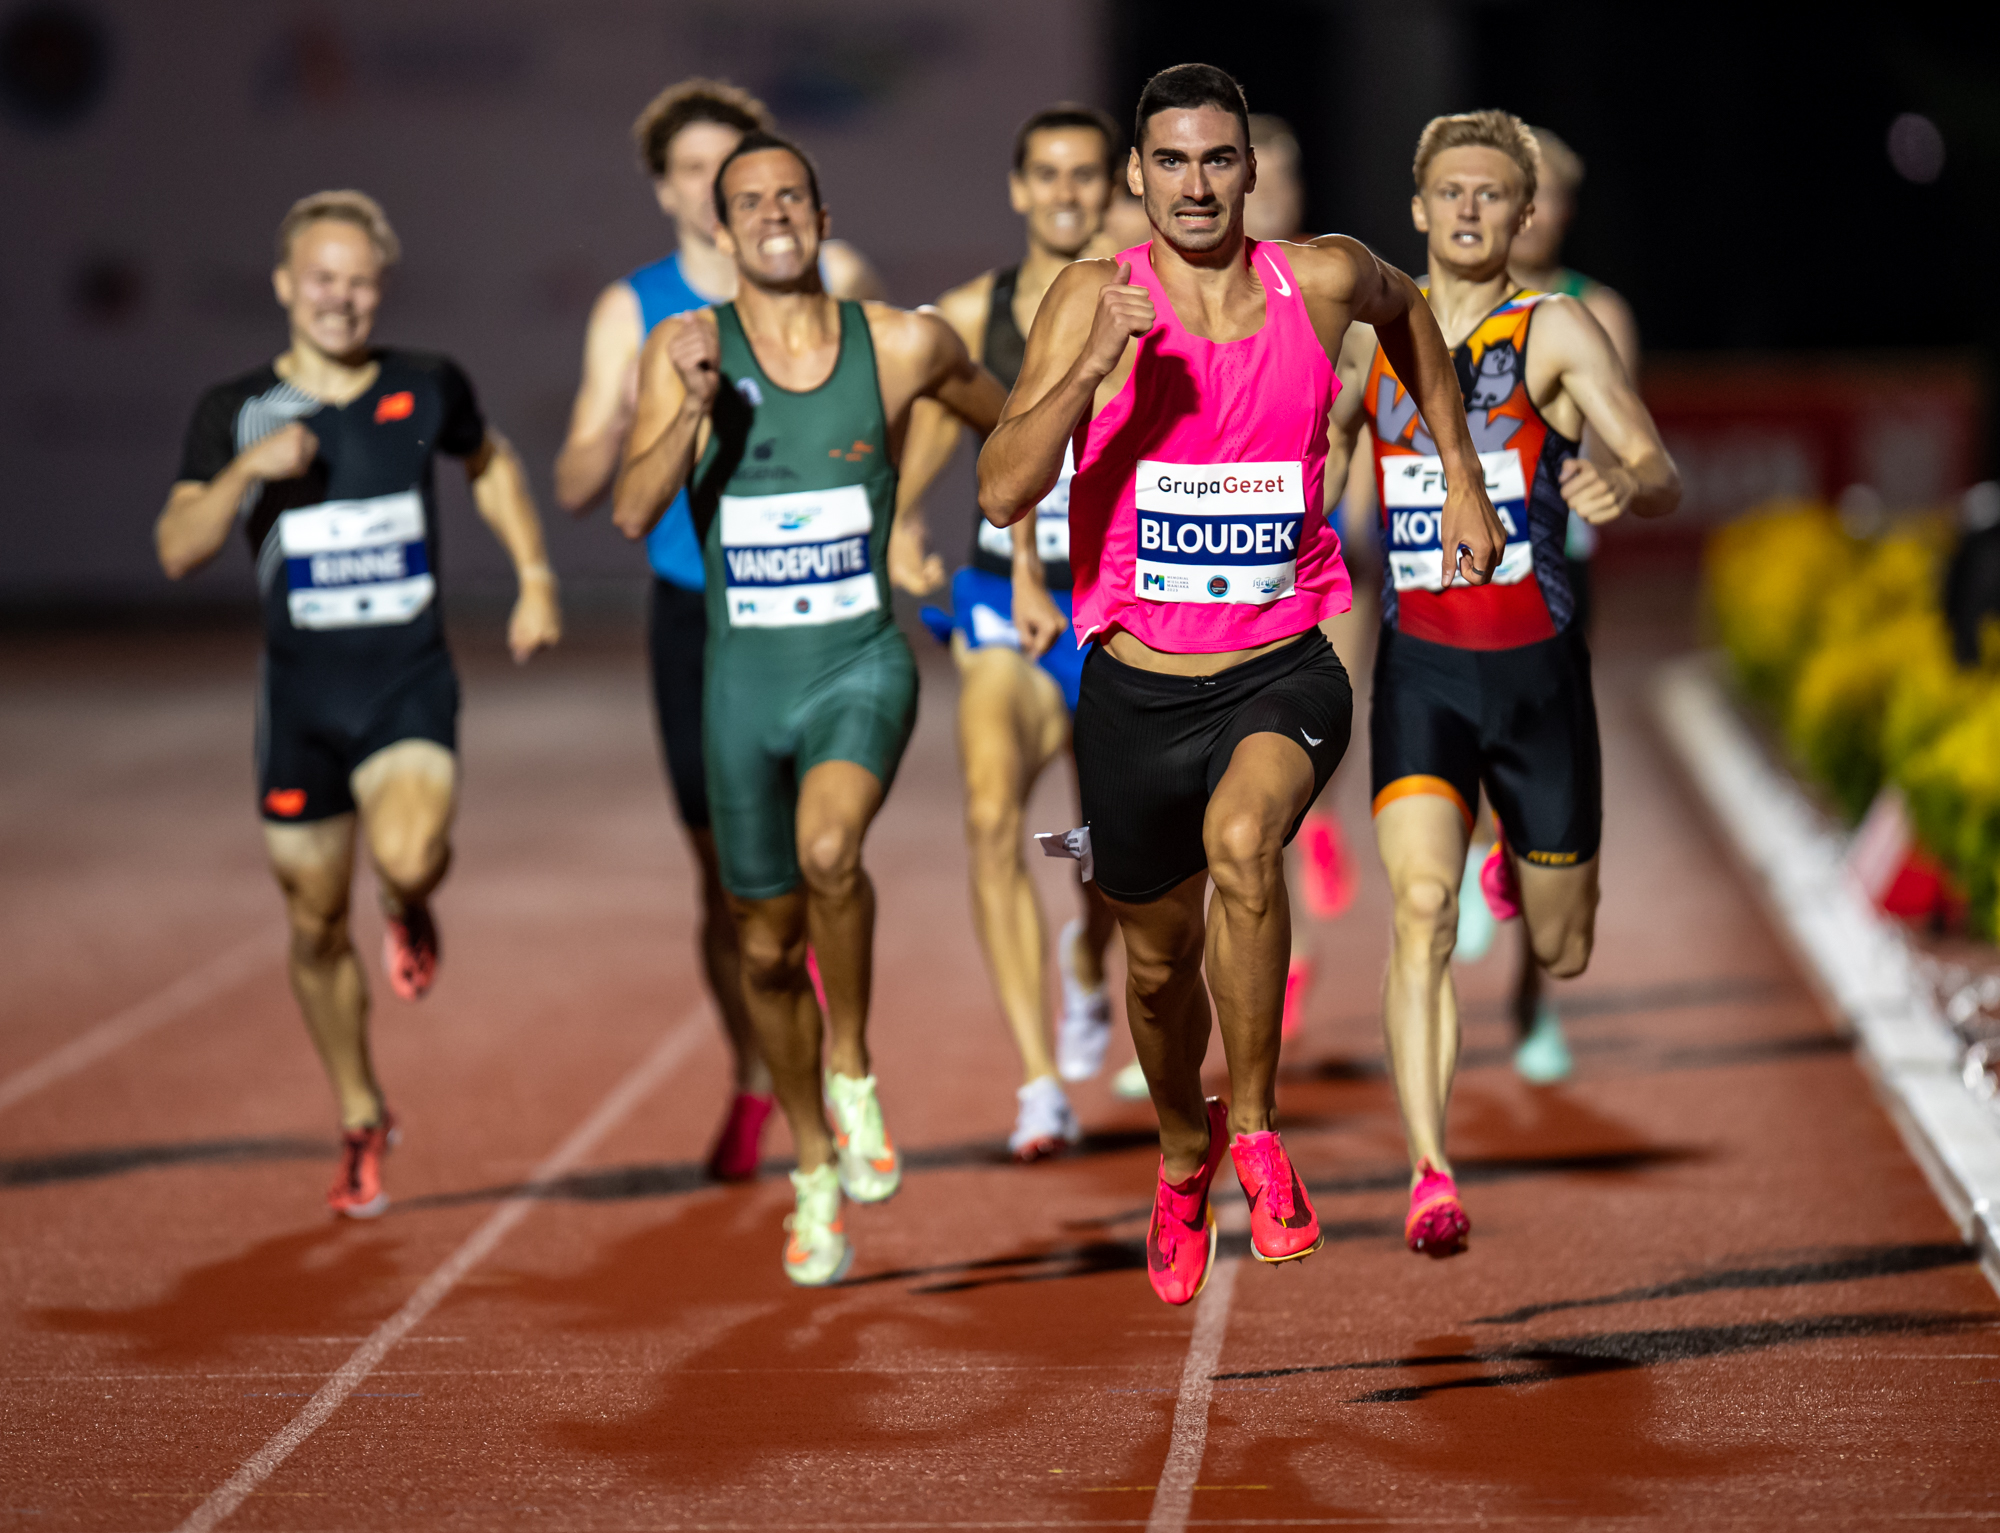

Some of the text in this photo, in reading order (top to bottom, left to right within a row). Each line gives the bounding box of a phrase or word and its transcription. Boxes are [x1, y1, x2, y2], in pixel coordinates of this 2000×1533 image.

[1157, 475, 1285, 499] GrupaGezet
[1422, 469, 1499, 493] FL
[1141, 518, 1297, 554] BLOUDEK
[1392, 505, 1518, 546] KOTA
[311, 543, 405, 587] RINNE
[726, 536, 866, 582] VANDEPUTTE
